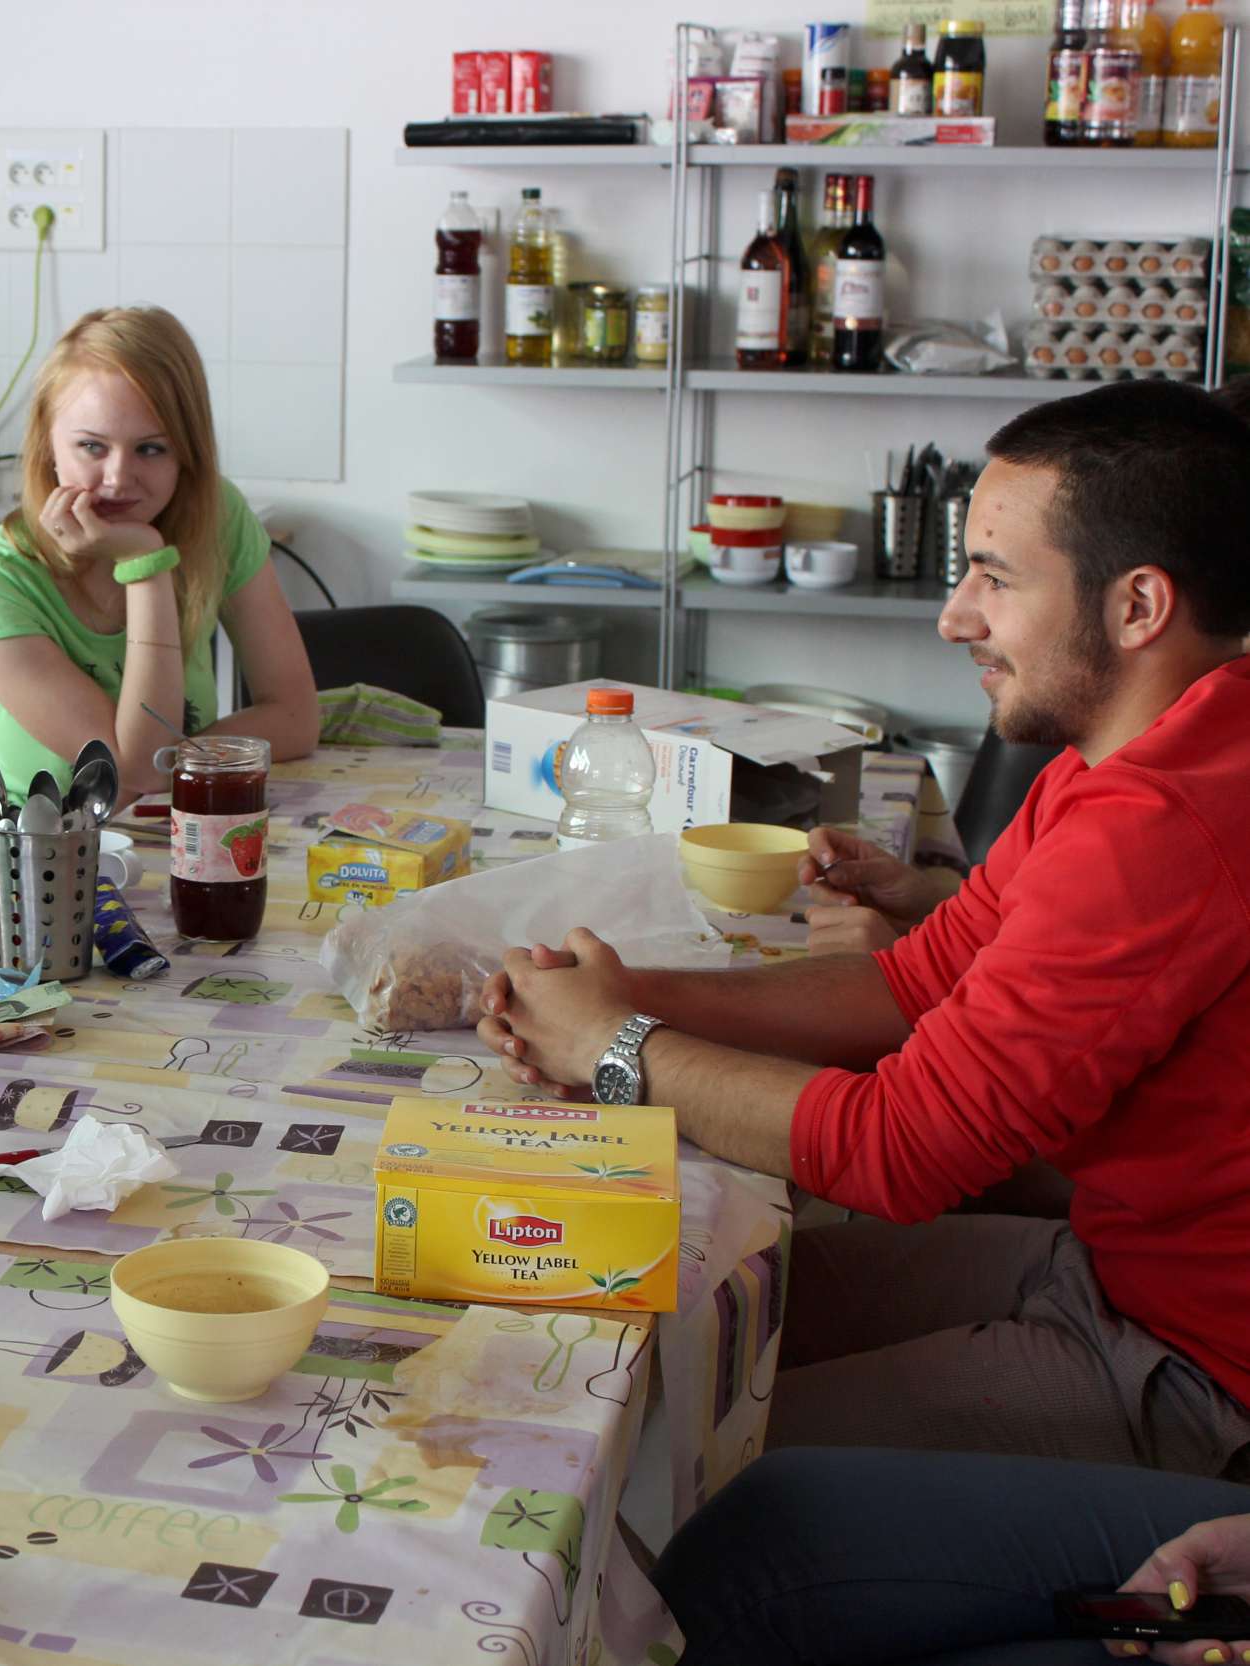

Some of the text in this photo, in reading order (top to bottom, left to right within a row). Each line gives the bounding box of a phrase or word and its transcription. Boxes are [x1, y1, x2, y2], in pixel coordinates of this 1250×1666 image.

[687, 746, 699, 812] Carrefour
[340, 866, 386, 879] DOLVITA
[474, 1104, 590, 1119] Lipton
[431, 1121, 630, 1145] YELLOW LABEL
[503, 1136, 553, 1148] TEA
[494, 1222, 558, 1240] Lipton
[472, 1250, 579, 1270] YELLOW LABEL
[510, 1268, 539, 1281] TEA
